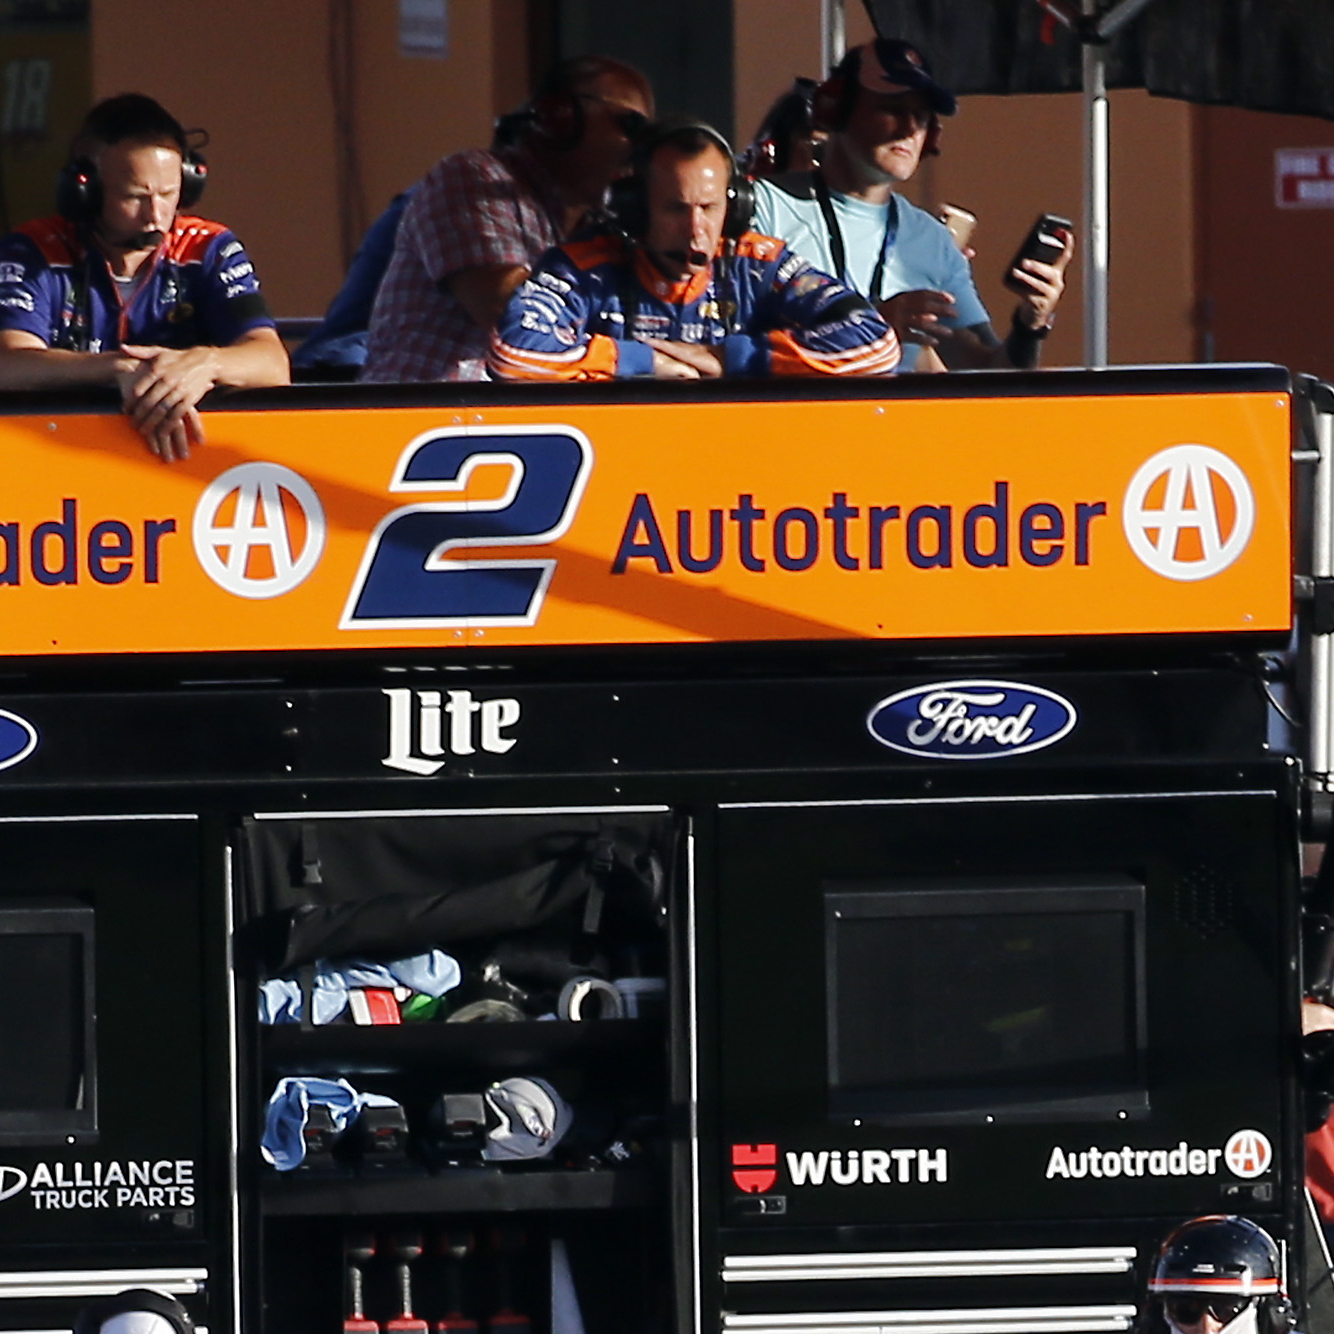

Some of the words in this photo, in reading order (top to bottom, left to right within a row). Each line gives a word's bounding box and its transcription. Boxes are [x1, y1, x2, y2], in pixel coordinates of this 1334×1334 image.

[2, 60, 51, 132] 18
[338, 424, 593, 629] 2
[610, 481, 1107, 575] Autotrader
[381, 688, 520, 775] Lite
[30, 1161, 194, 1188] ALLIANCE
[1045, 1142, 1222, 1180] Autotrader
[30, 1190, 109, 1209] TRUCK
[117, 1187, 195, 1207] PARTS
